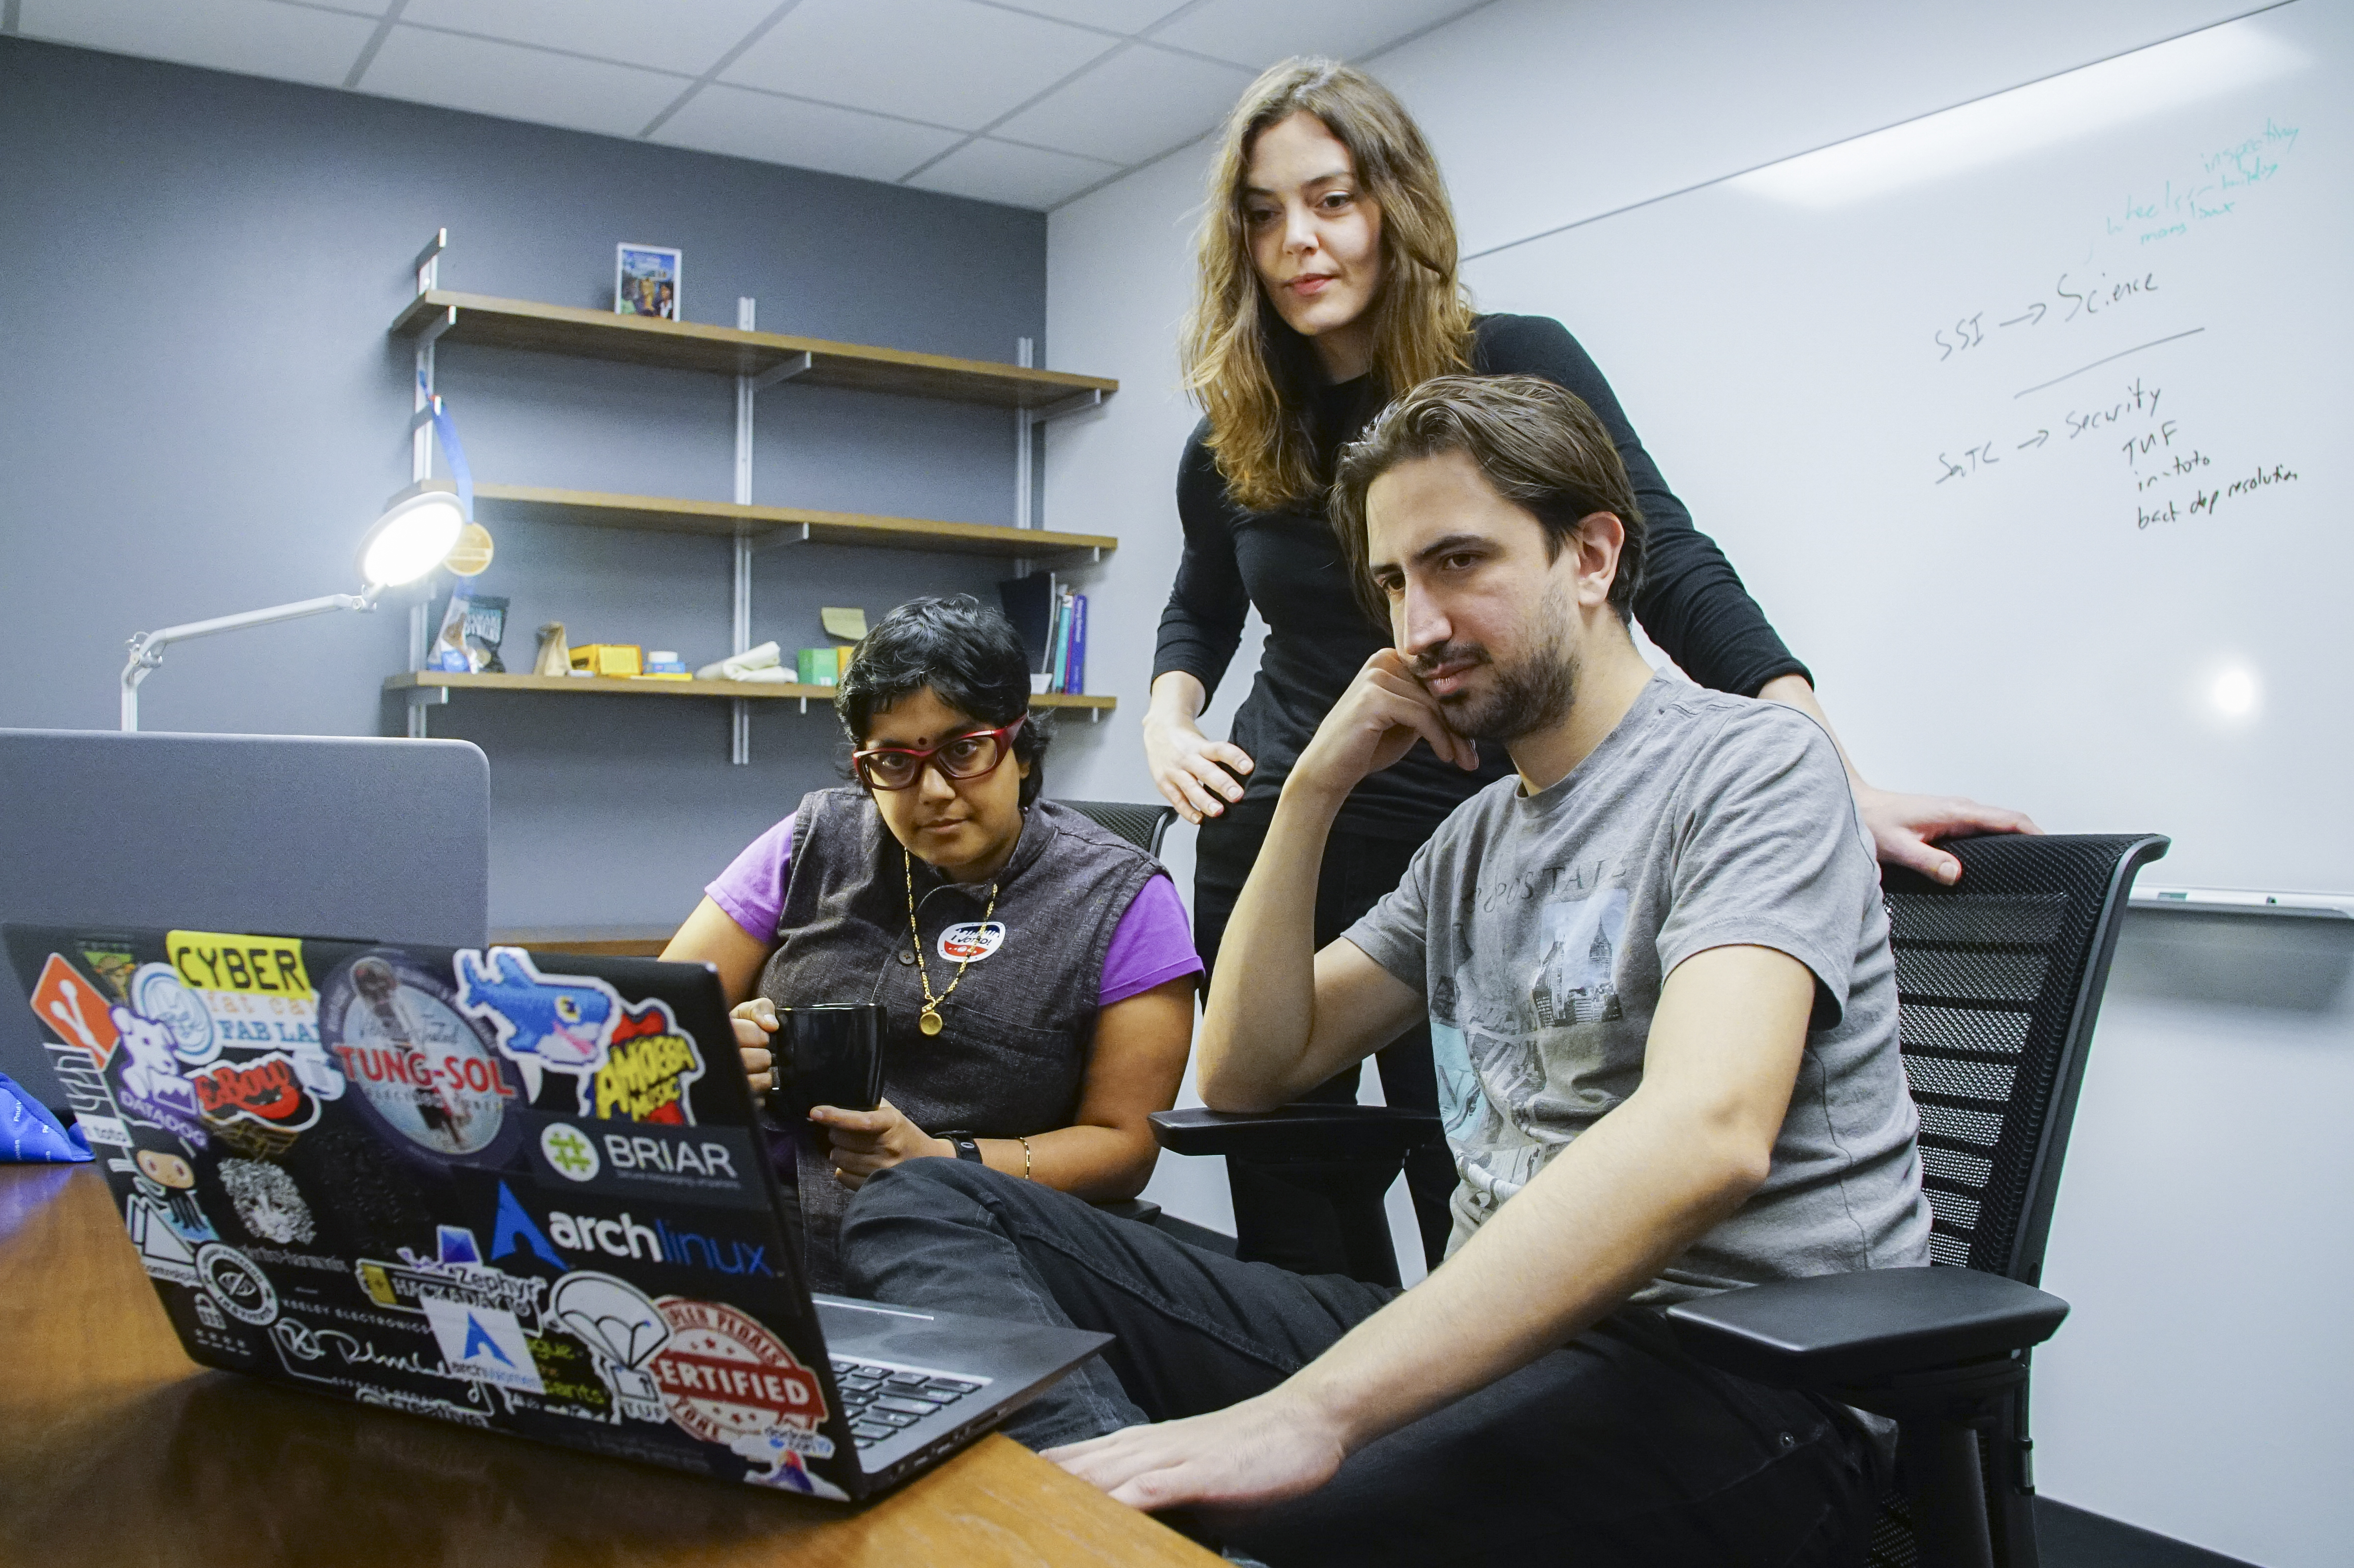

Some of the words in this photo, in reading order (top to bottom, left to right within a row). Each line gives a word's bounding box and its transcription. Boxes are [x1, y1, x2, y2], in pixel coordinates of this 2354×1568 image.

[2056, 272, 2159, 322] Science
[177, 946, 306, 991] CYBER
[218, 1019, 270, 1041] FAB
[333, 1045, 514, 1096] TUNG-SOL
[595, 1035, 696, 1121] AMOEBA
[119, 1090, 208, 1147] DATADOG
[603, 1134, 737, 1179] BRIAR
[549, 1211, 774, 1275] archlinux
[454, 1265, 537, 1300] Zephyr
